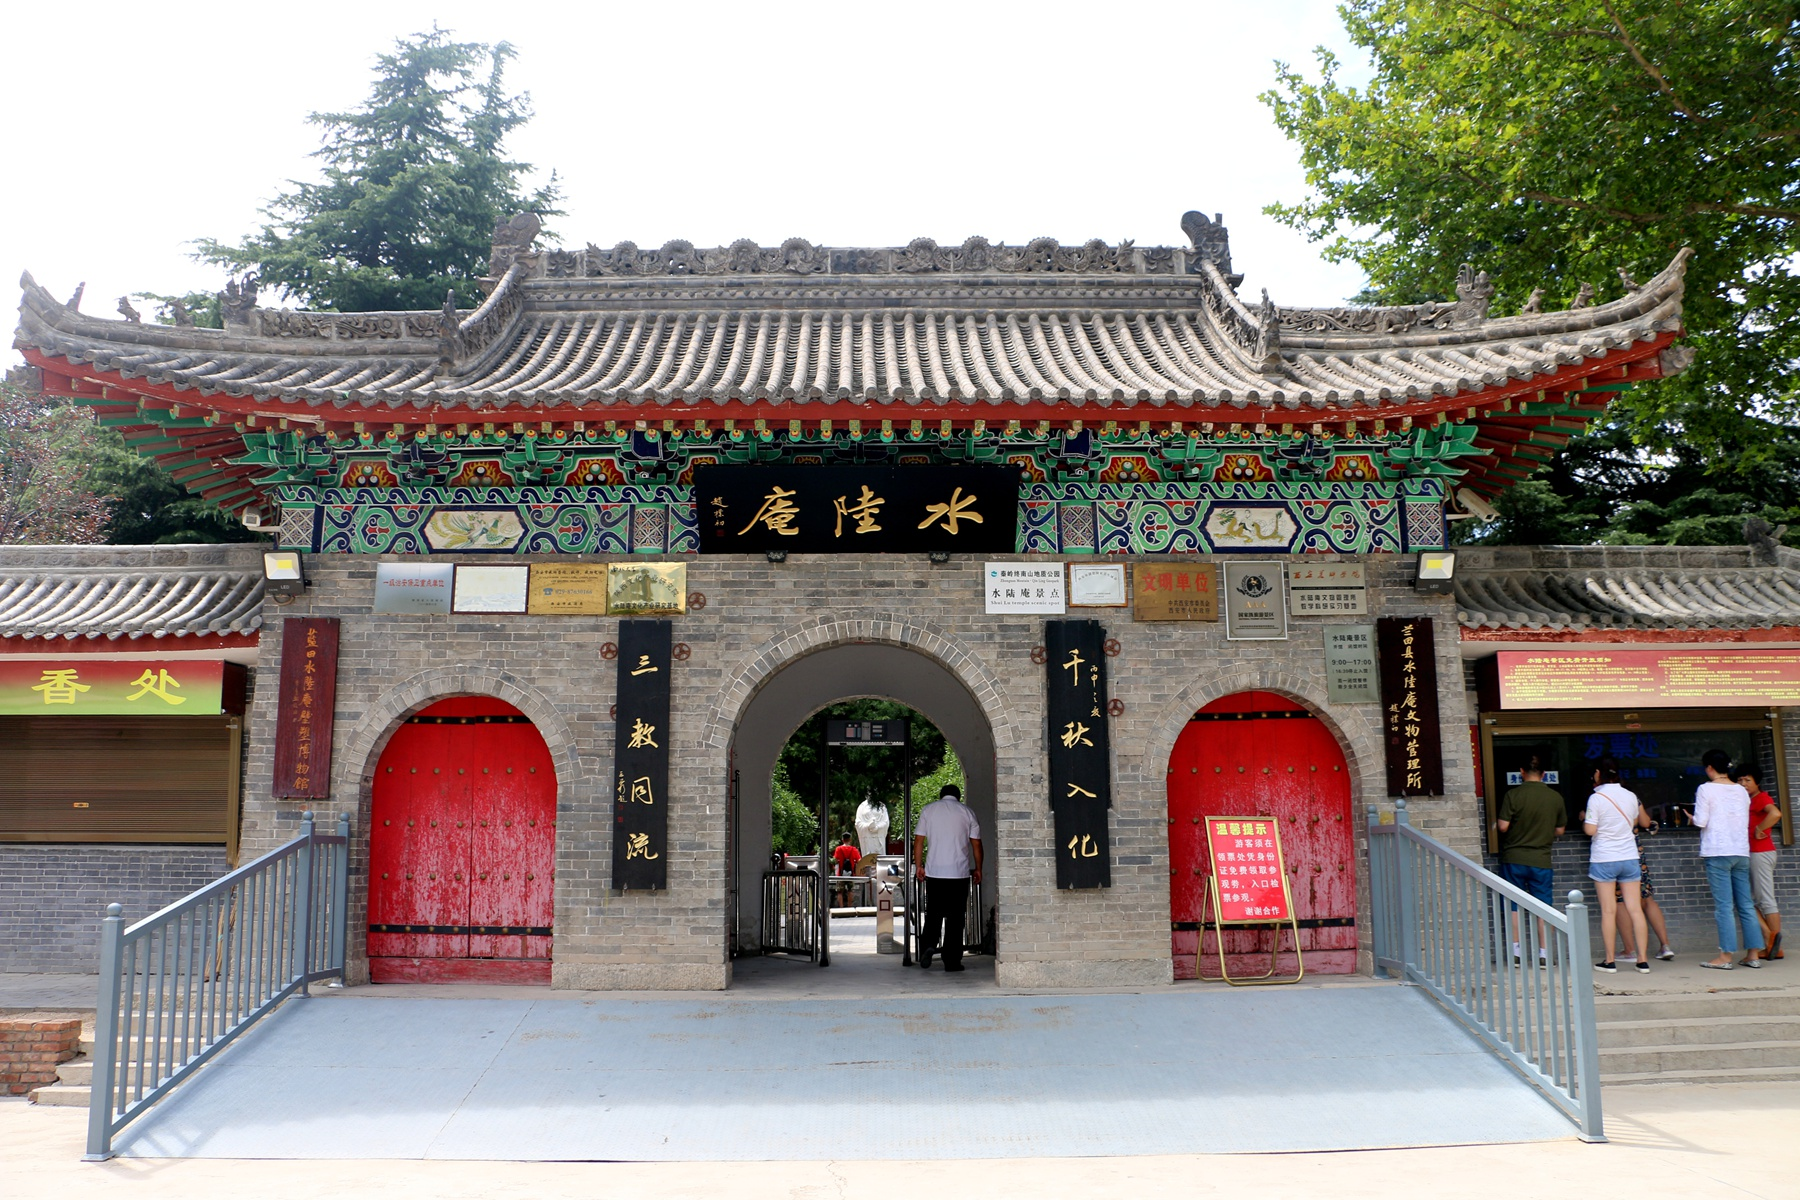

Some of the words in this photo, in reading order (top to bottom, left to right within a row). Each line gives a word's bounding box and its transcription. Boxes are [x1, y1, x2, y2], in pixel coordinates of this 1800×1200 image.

[1000, 570, 1060, 578] 秦岭终南山地质公园
[1141, 572, 1209, 593] 文明单位
[991, 588, 1060, 598] 水陆庵景点
[31, 669, 187, 705] 香处
[626, 655, 659, 860] 三教同流
[1216, 823, 1267, 836] 温馨提示
[1235, 839, 1273, 848] 游客须在
[1217, 852, 1275, 862] 领票处凭身份
[1219, 866, 1277, 875] 证免费领取参
[878, 881, 892, 911] 入口
[1223, 893, 1254, 903] 票参观。
[1245, 906, 1280, 916] 谢谢合作
